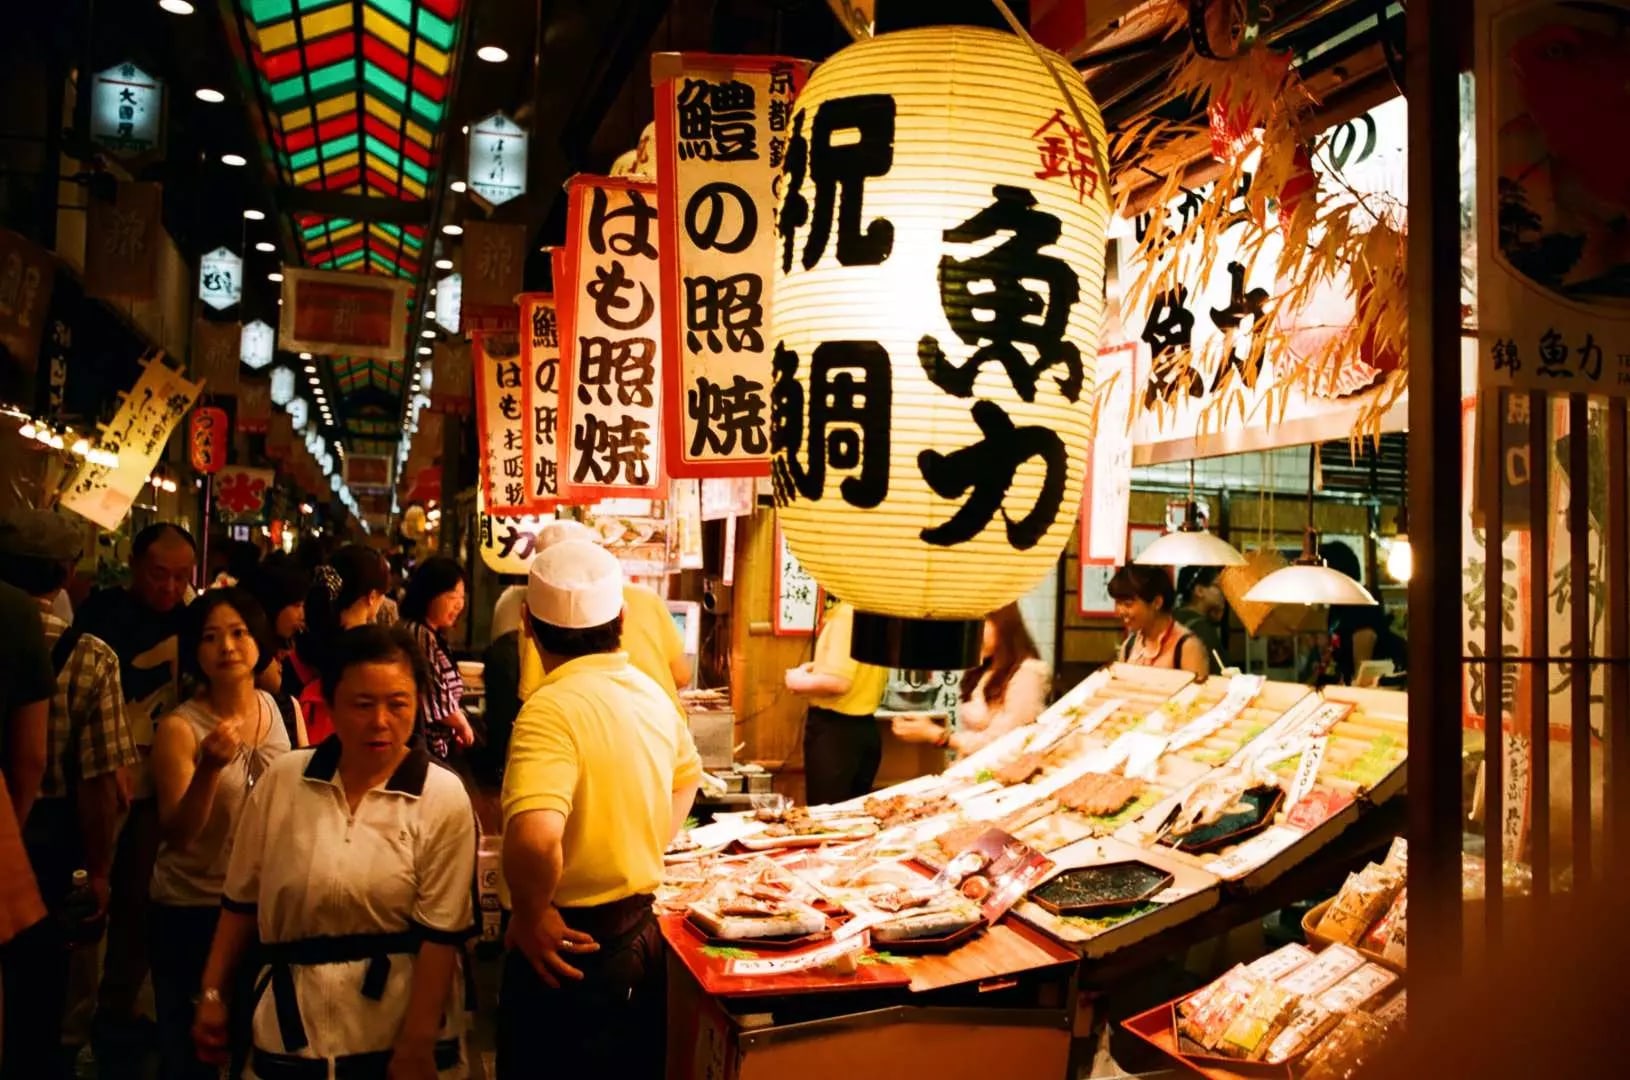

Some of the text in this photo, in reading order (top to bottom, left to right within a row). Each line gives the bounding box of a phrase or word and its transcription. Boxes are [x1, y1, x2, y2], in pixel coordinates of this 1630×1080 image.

[572, 188, 659, 487] はも照焼
[675, 79, 770, 457] 鱧の照焼
[918, 185, 1084, 551] 魚力
[1536, 327, 1604, 381] 魚力
